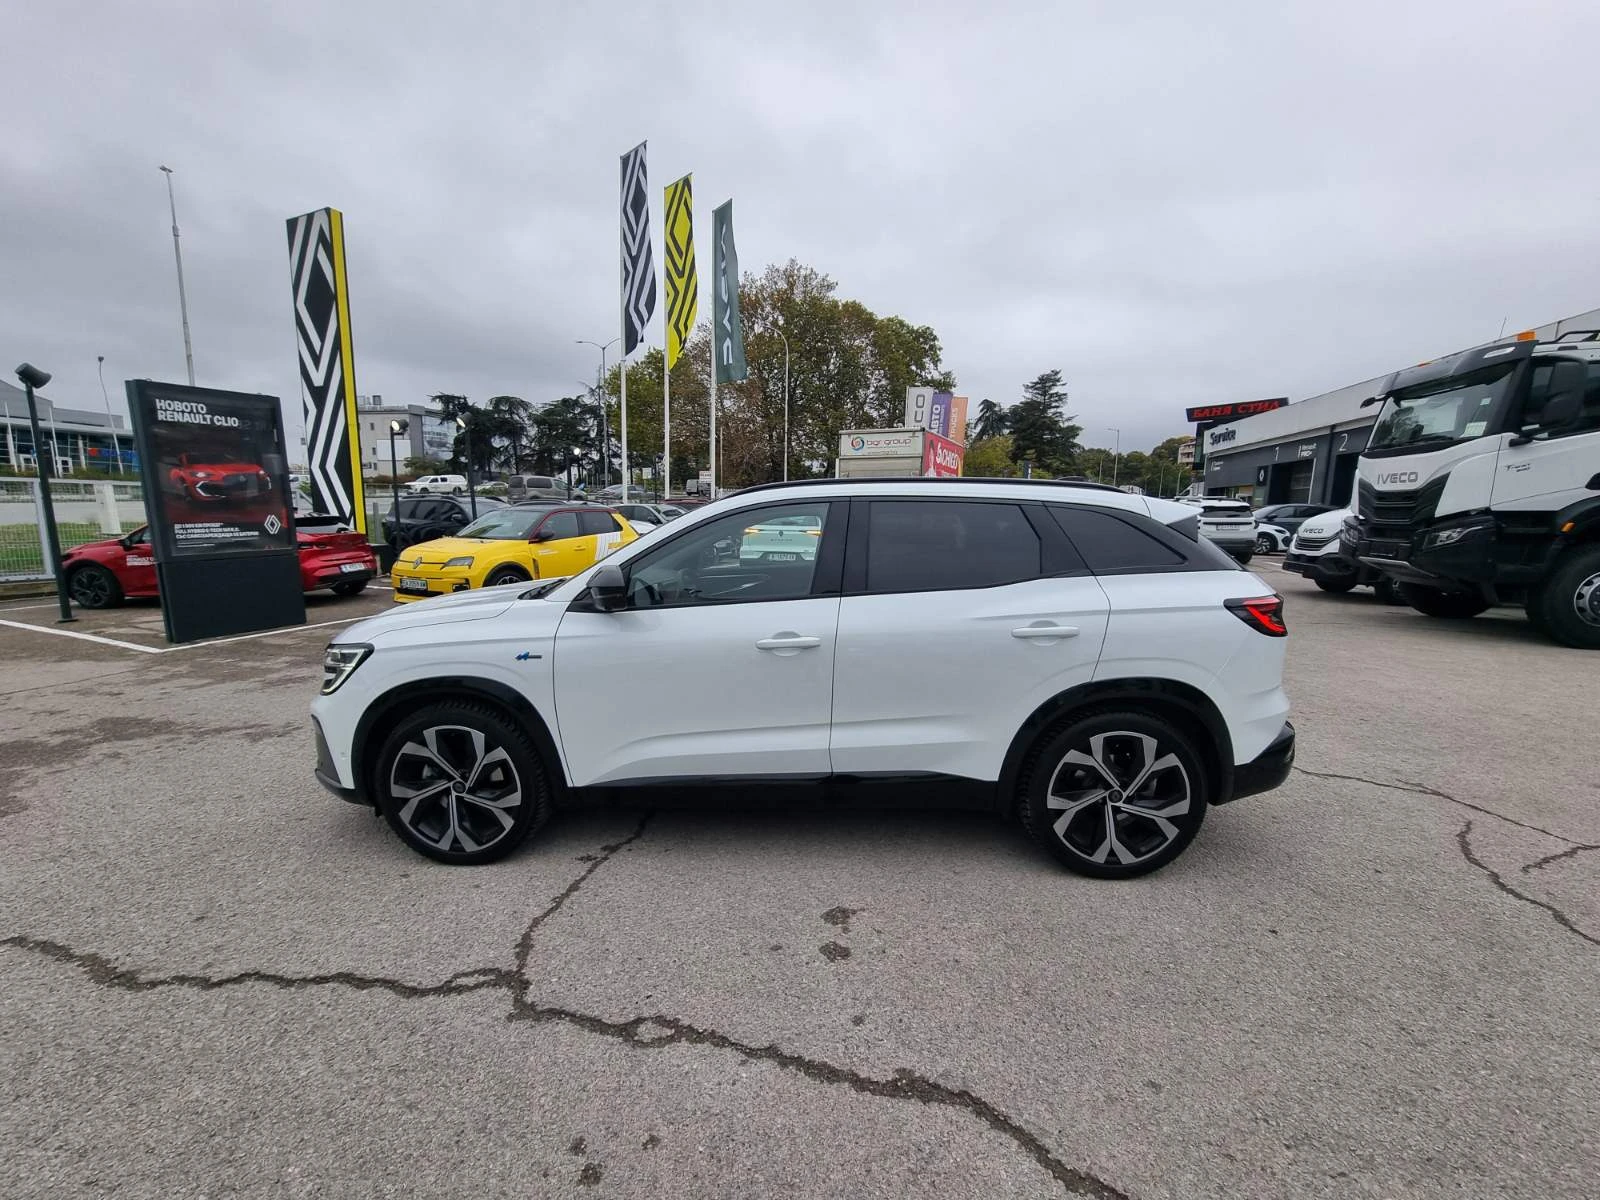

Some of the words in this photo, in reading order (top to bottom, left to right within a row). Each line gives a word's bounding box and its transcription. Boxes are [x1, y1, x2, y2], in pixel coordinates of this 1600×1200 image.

[156, 398, 207, 414] НОВОТО
[1193, 405, 1232, 418] БАНЯ
[157, 410, 212, 425] RENAULT
[214, 415, 239, 427] CLIO
[1209, 427, 1237, 445] Service
[1339, 433, 1348, 452] 2
[1275, 446, 1280, 462] 1
[1377, 471, 1418, 485] IVECO
